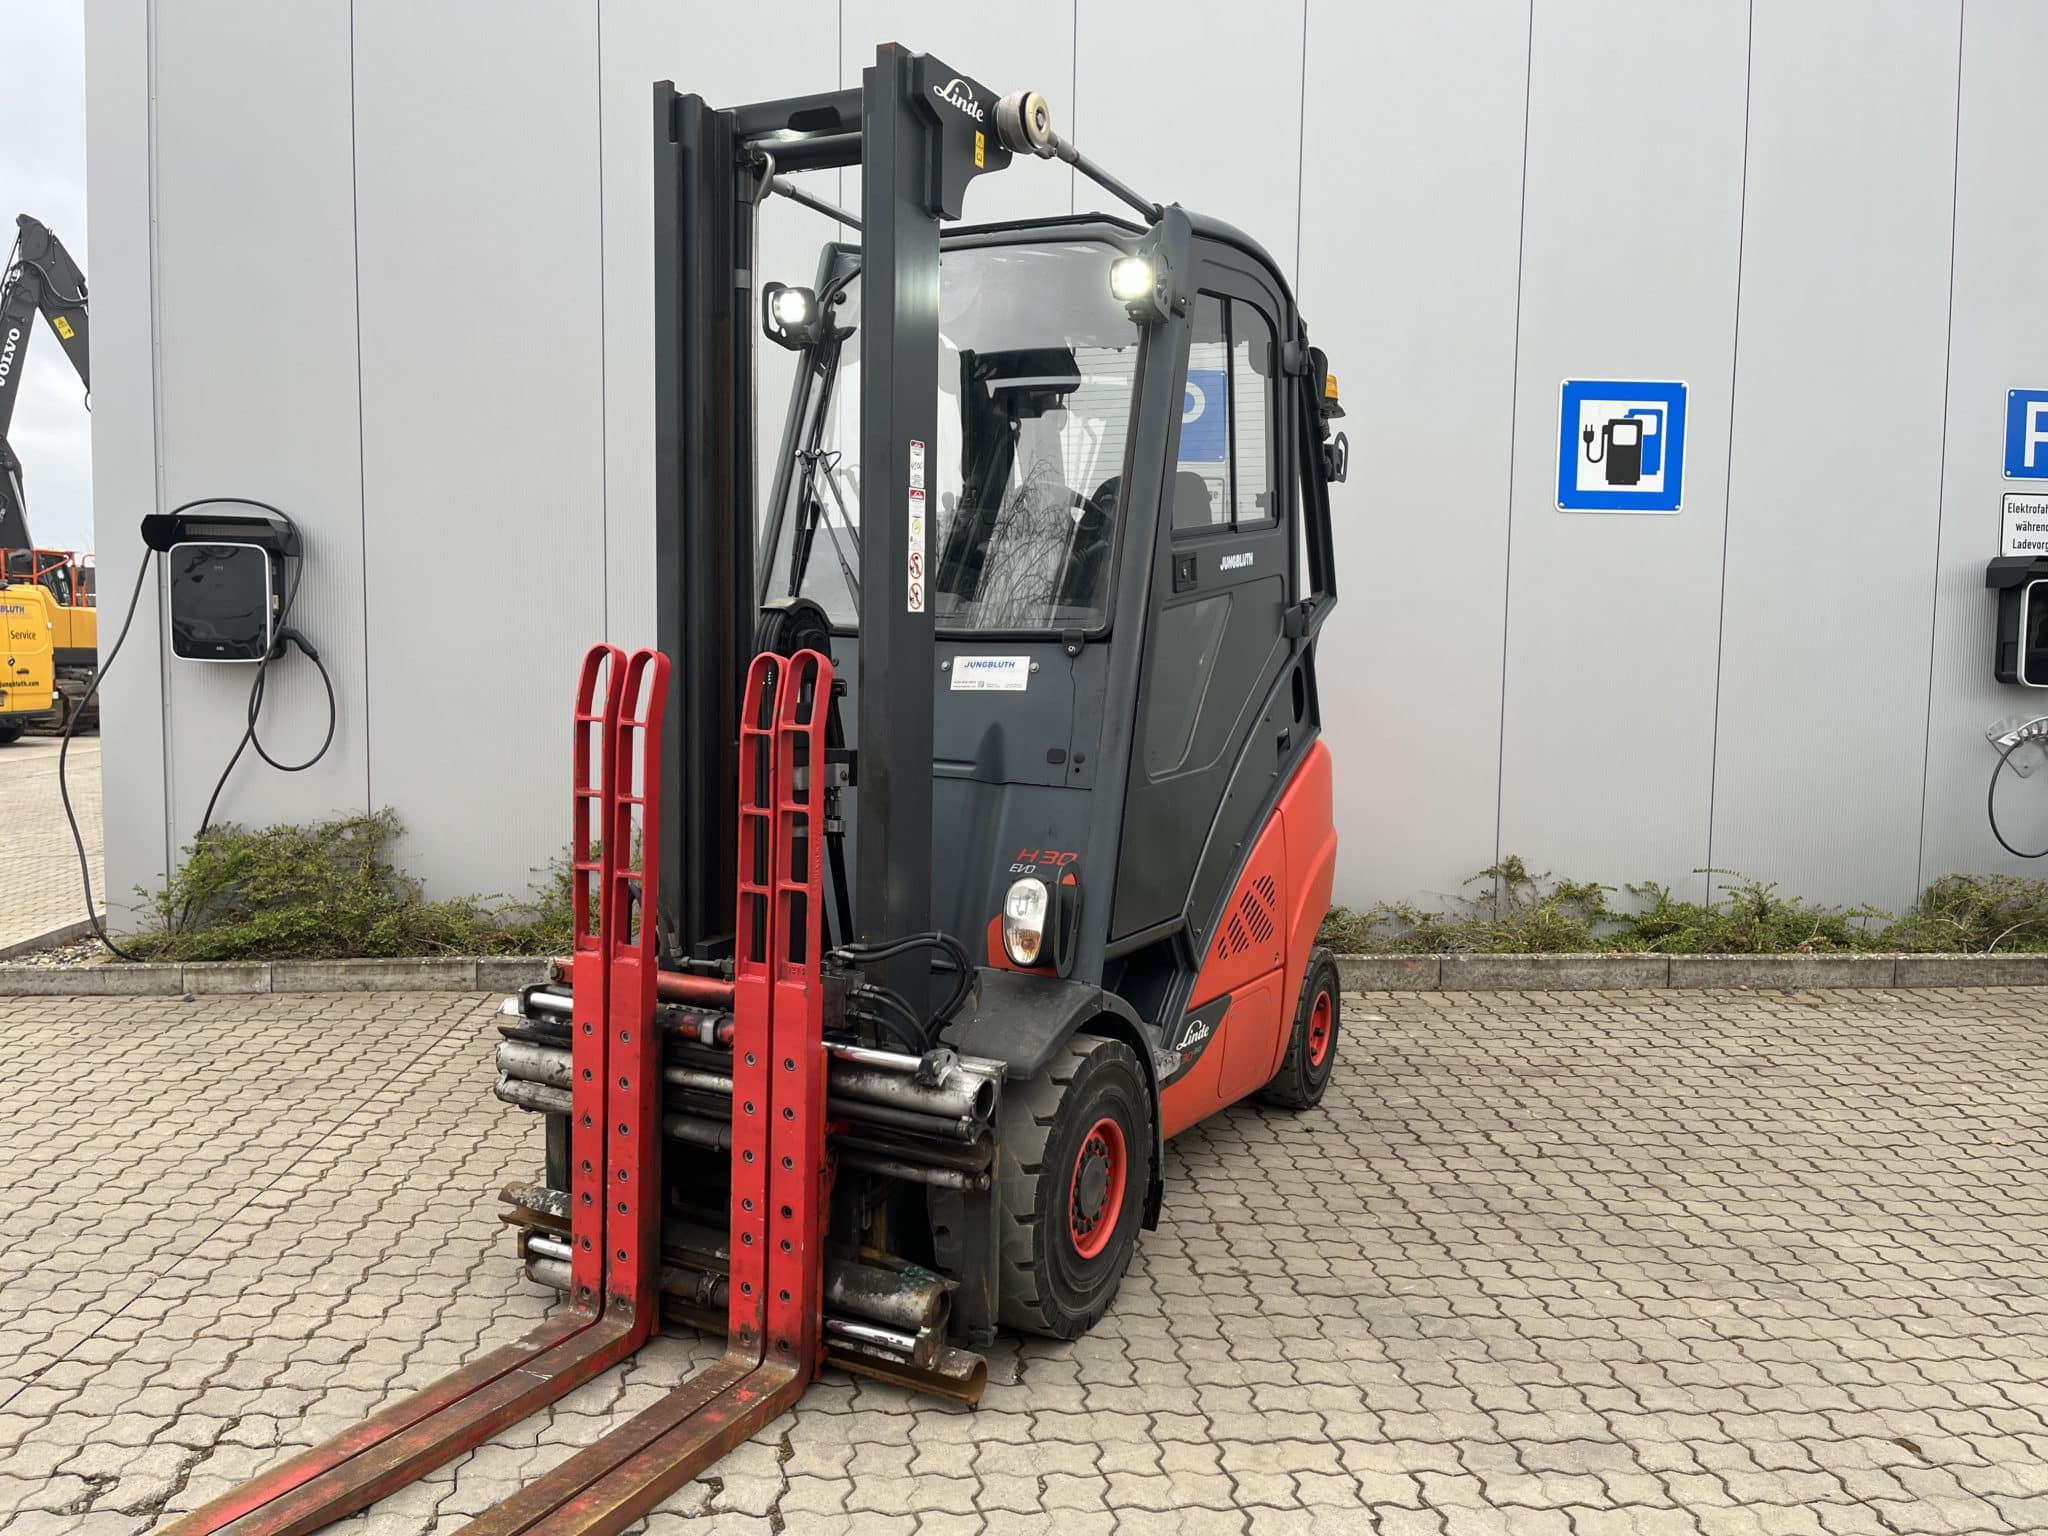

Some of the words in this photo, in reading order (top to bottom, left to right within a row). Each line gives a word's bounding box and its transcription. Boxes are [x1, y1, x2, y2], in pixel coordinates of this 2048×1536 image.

[933, 78, 984, 122] Linde
[1220, 552, 1253, 571] JUNGBLUTH
[10, 630, 37, 640] Service
[964, 661, 1016, 669] JUNGBLUTH
[1009, 863, 1036, 874] EVO
[1176, 1019, 1210, 1051] Linde
